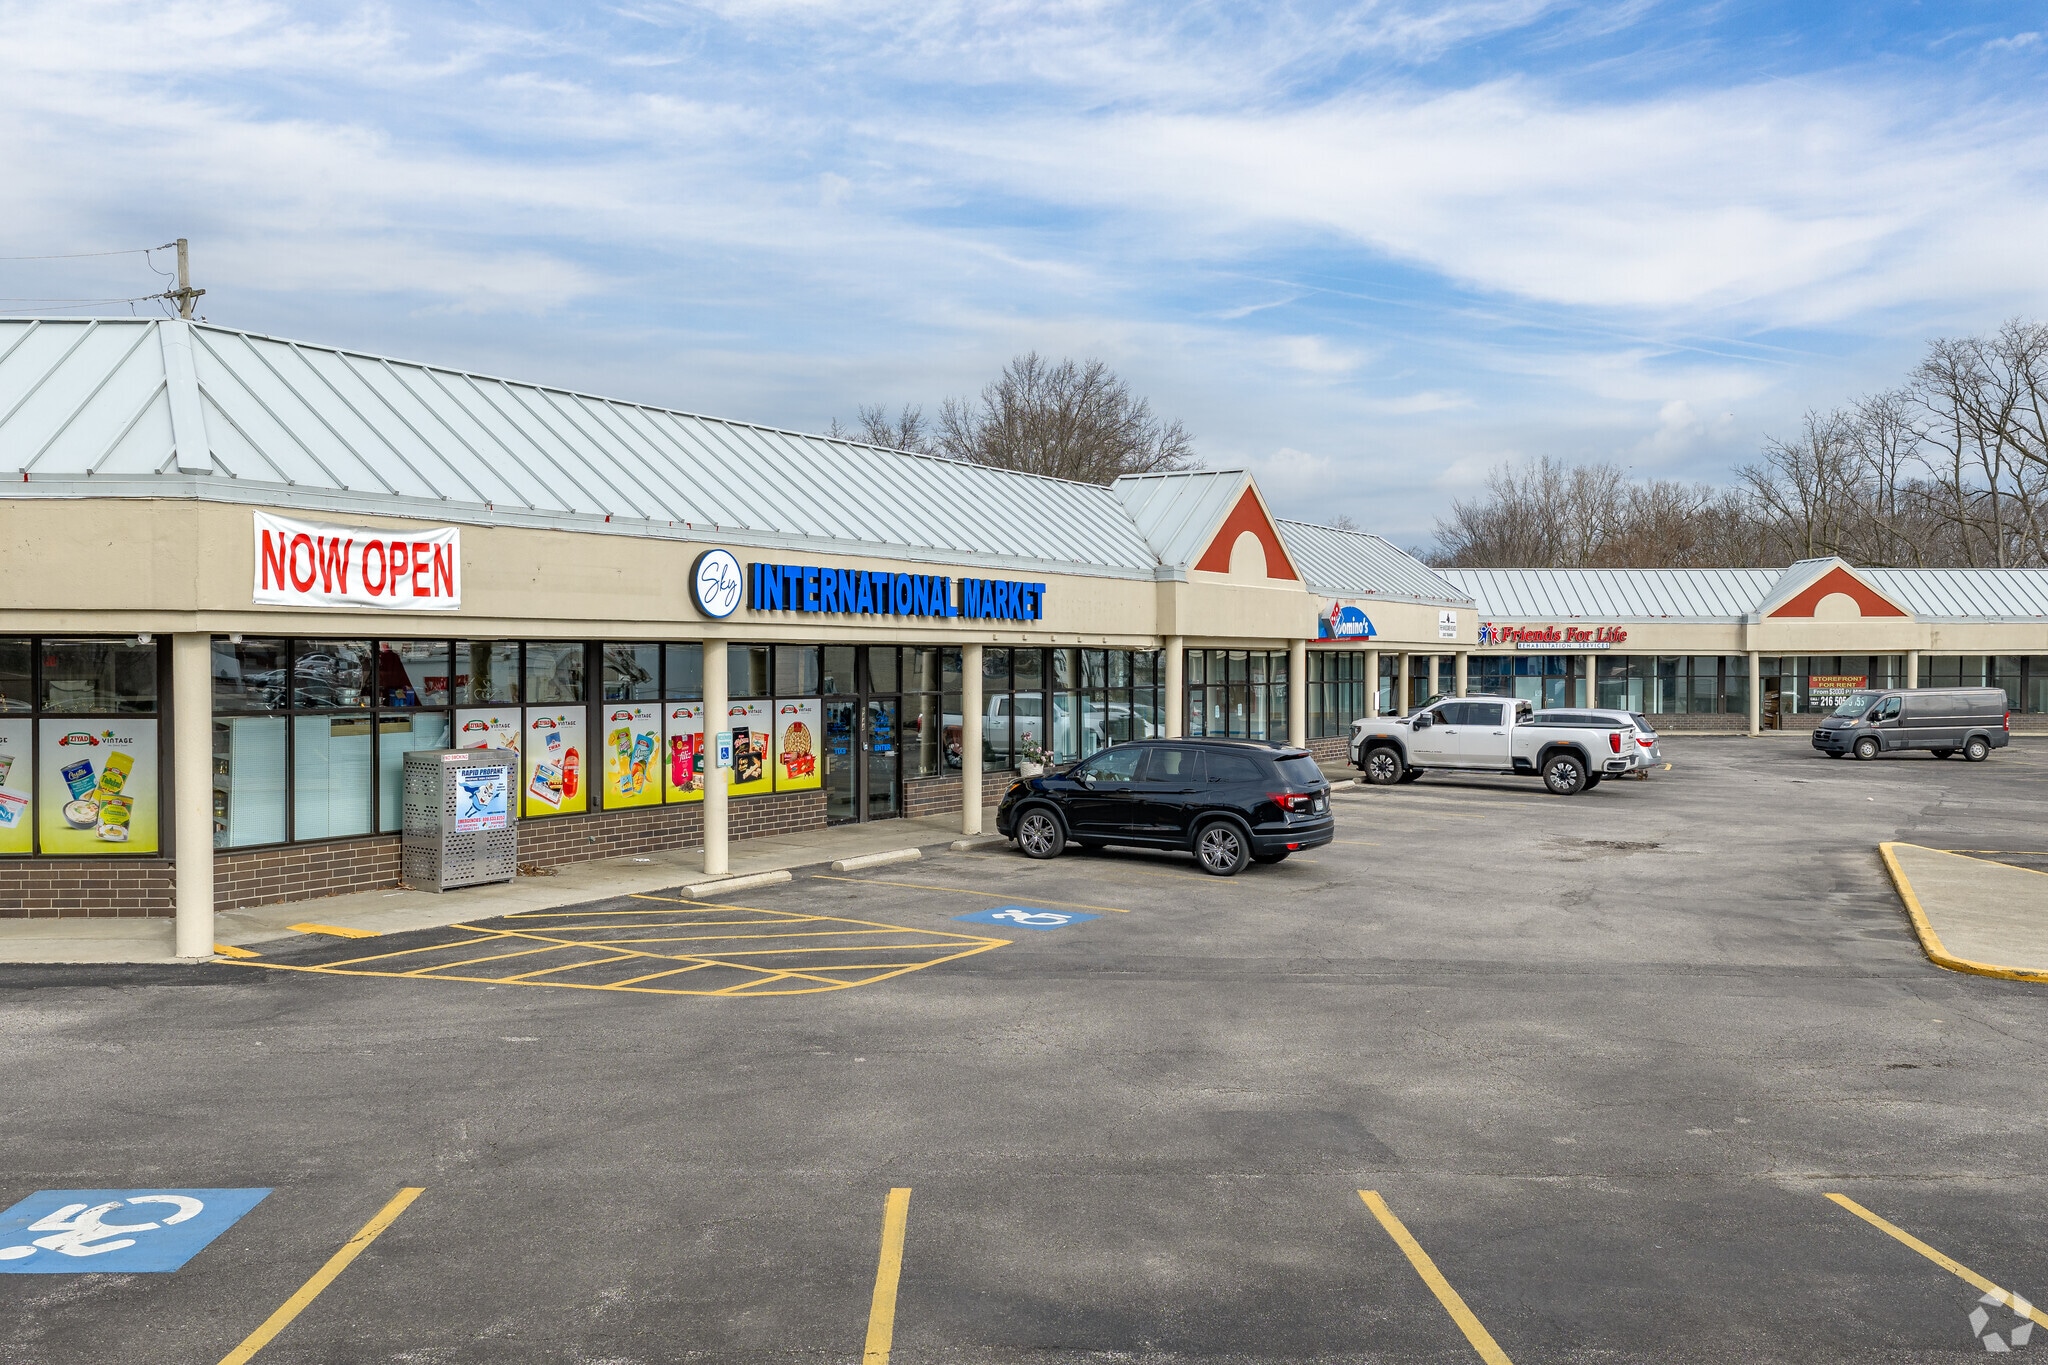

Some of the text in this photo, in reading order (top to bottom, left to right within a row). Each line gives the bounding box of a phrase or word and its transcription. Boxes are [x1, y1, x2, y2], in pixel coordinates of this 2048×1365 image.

[262, 529, 454, 598] NOW OPEN
[701, 562, 738, 606] Sky
[752, 562, 1047, 620] INTERNATIONAL MARKET
[1339, 616, 1369, 635] omino's
[1501, 626, 1628, 642] Friends For Life
[1820, 696, 1833, 707] 216
[480, 767, 503, 775] PROPANE
